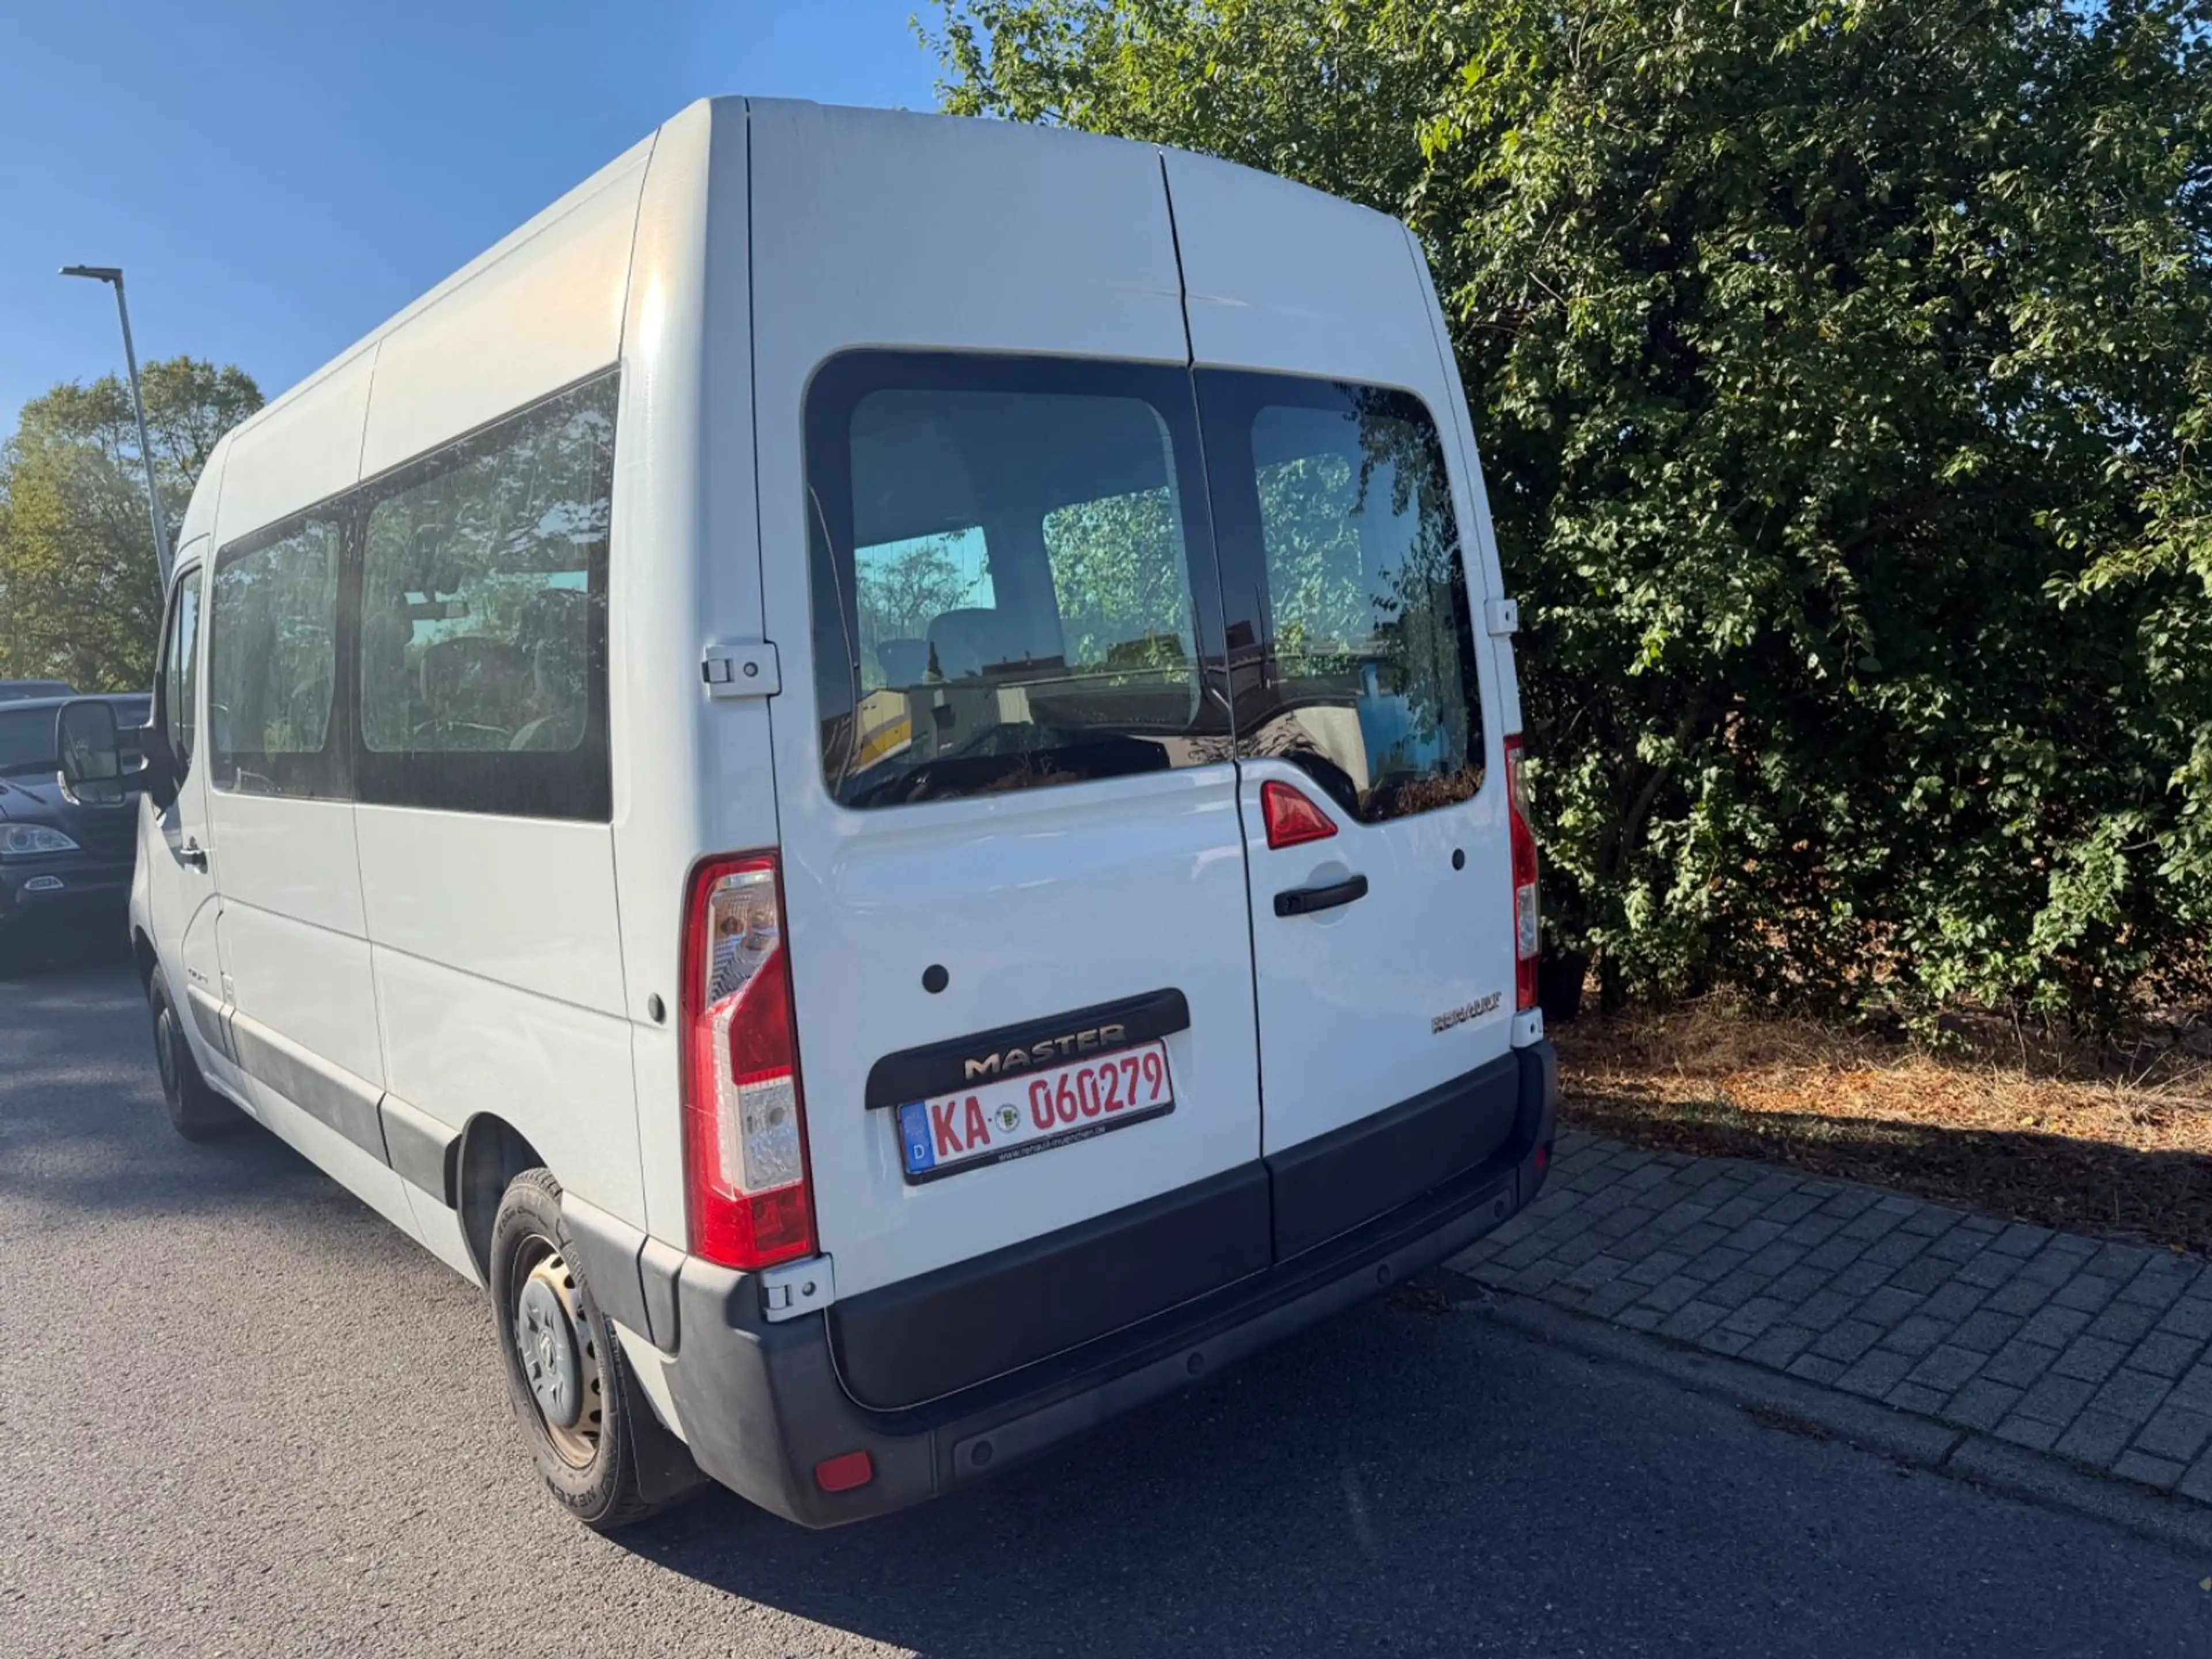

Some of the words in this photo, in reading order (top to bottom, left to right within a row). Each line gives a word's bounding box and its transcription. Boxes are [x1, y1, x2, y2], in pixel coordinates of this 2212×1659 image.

[964, 1023, 1126, 1080] MASTER
[931, 1096, 991, 1157] KA
[1028, 1051, 1164, 1130] 060279
[914, 1143, 925, 1160] D
